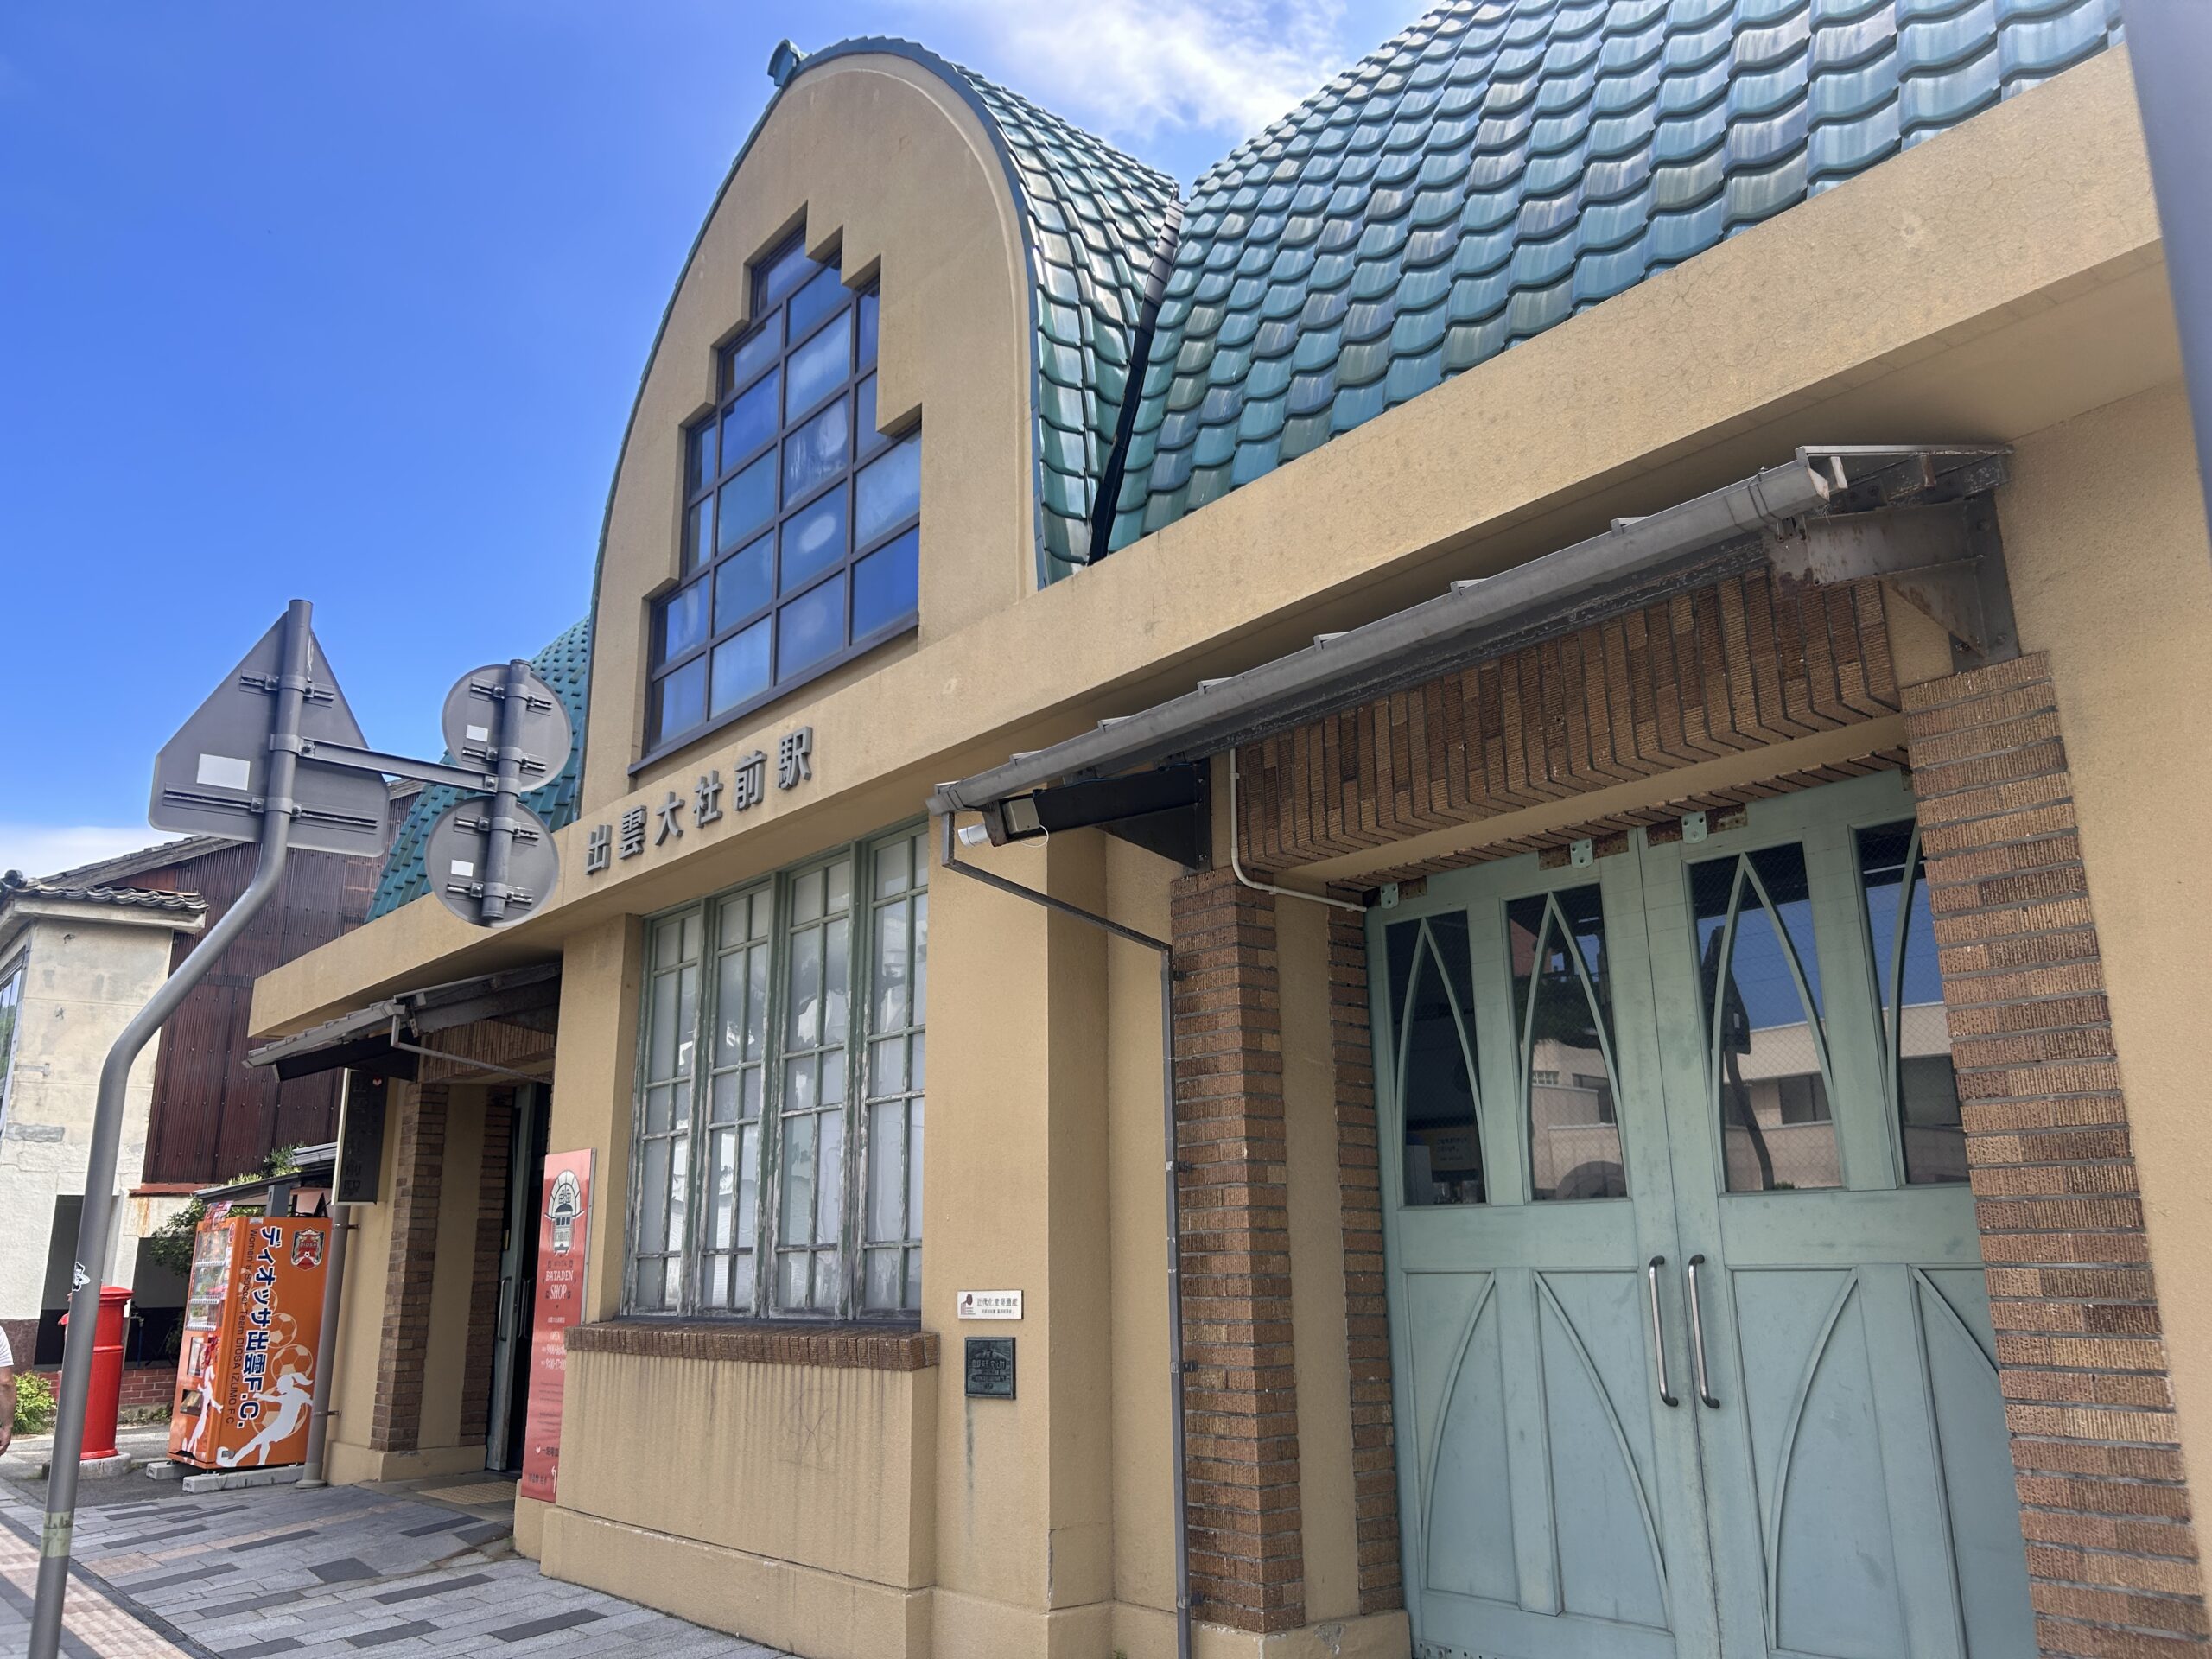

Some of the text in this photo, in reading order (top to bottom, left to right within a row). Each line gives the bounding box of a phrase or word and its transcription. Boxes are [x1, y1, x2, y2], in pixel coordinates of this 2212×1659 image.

[586, 726, 812, 875] 出雲大社前駅
[245, 1228, 258, 1270] Women's
[242, 1273, 252, 1306] Soccer
[545, 1270, 574, 1281] BATADEN
[550, 1284, 568, 1300] SHOP
[237, 1309, 248, 1335] Team
[238, 1226, 283, 1428] ディオッサ出雲F.C.
[233, 1338, 245, 1369] DIOSA
[228, 1372, 240, 1406] IZUMO
